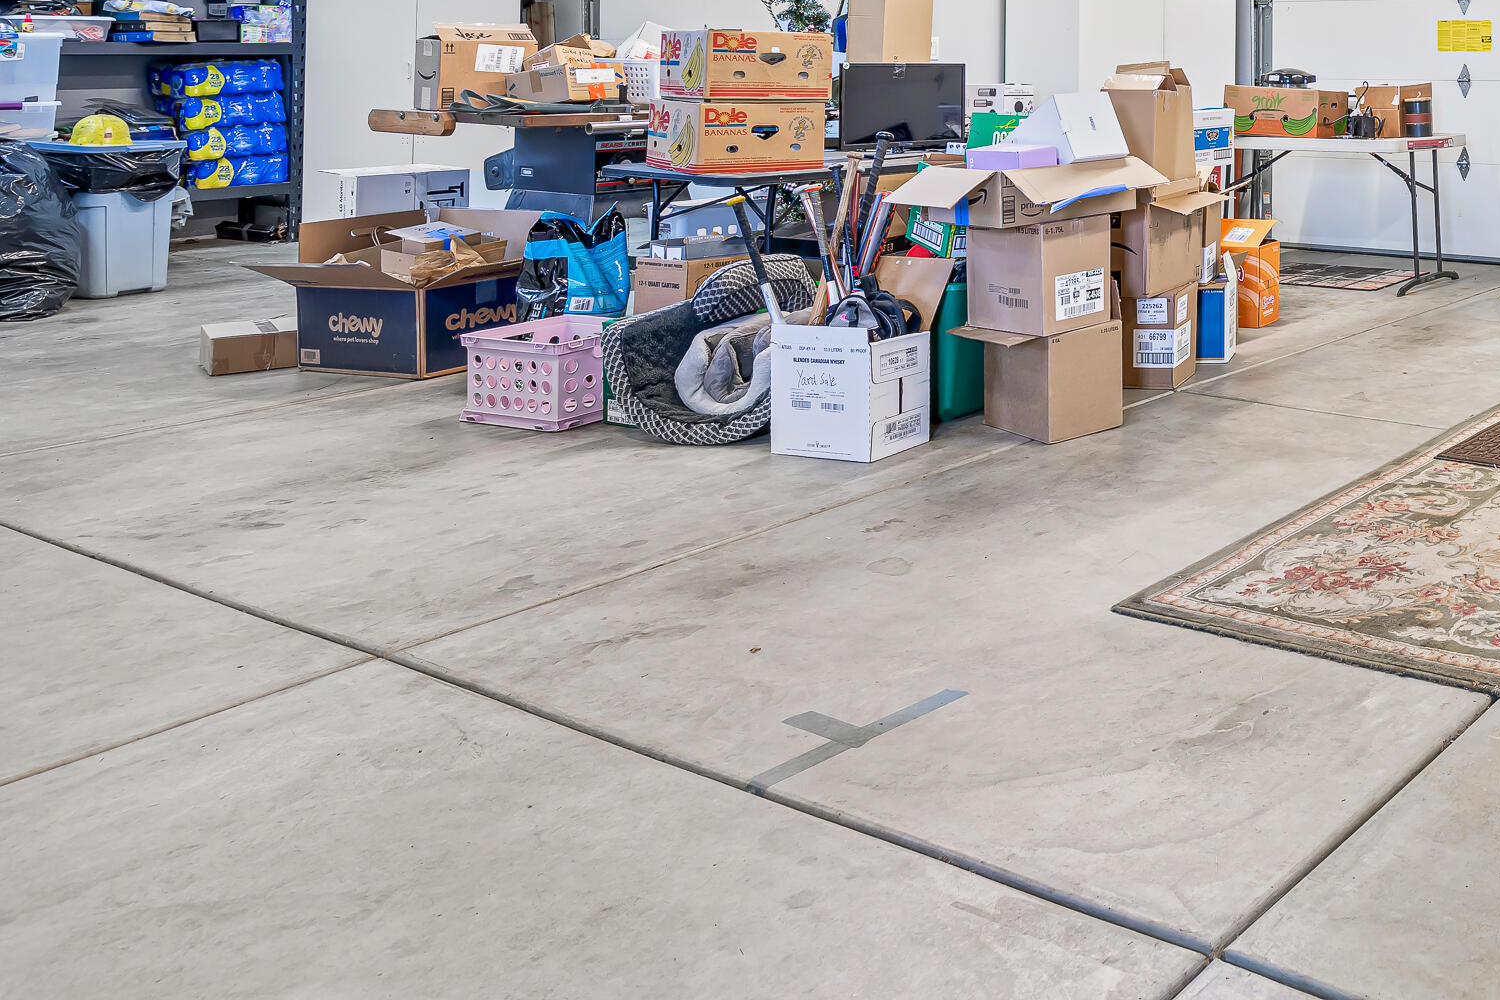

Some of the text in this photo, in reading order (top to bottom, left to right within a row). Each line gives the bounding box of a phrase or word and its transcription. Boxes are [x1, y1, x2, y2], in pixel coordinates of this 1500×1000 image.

[661, 33, 682, 59] Dole
[712, 32, 757, 51] Dole
[712, 54, 757, 63] BANANAS
[649, 103, 670, 133] Dole
[704, 107, 748, 125] Dole
[704, 129, 747, 137] BANANAS
[328, 312, 383, 337] chewy
[445, 303, 517, 331] chewy
[333, 335, 346, 343] where
[796, 369, 837, 388] Yard Sale
